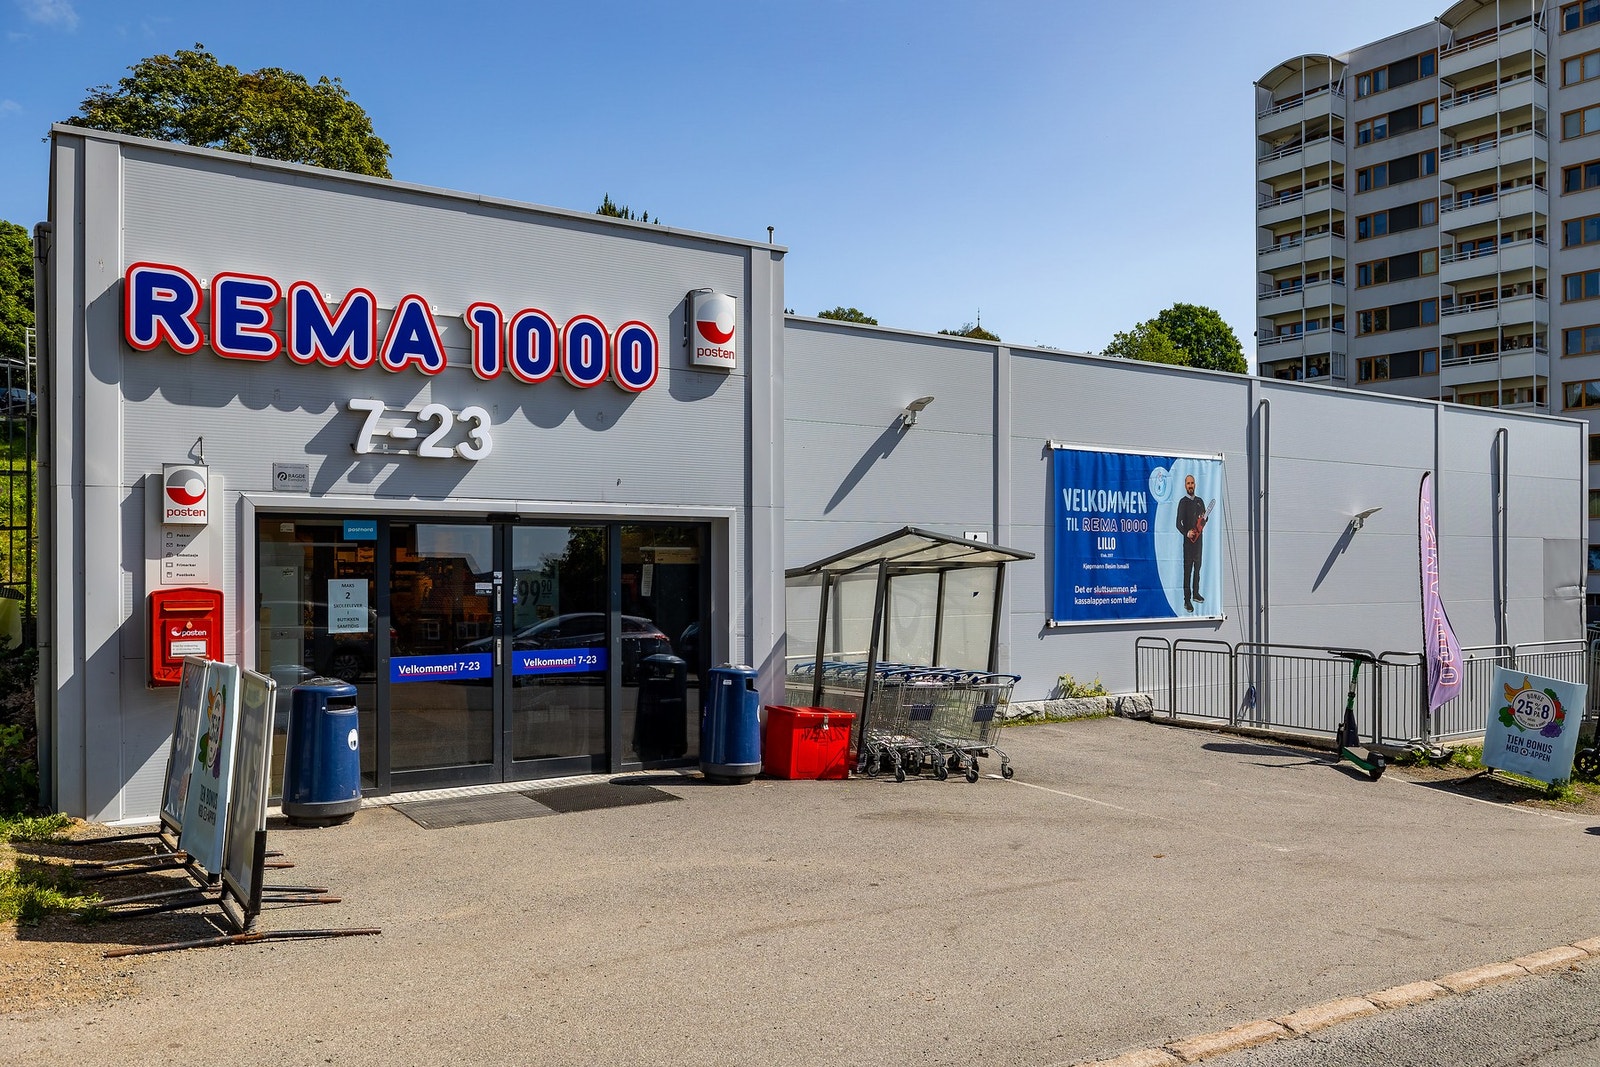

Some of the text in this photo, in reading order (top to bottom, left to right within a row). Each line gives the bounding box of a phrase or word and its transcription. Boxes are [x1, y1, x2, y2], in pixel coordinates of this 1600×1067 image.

[124, 261, 659, 392] REMA 1000
[696, 346, 735, 360] posten
[348, 398, 493, 461] 7-23
[1062, 488, 1147, 513] VELKOMMEN
[166, 507, 206, 518] posten
[1066, 517, 1148, 533] TIL REMA 1000
[1097, 536, 1116, 550] LILLO
[345, 592, 351, 600] 2
[1074, 585, 1086, 594] Det
[1093, 585, 1130, 594] sluttsummen
[1129, 584, 1138, 594] på
[1074, 597, 1110, 605] kassalappen
[181, 629, 207, 638] posten
[398, 661, 480, 676] Velkommen! 7-23
[523, 655, 597, 668] Velkommen! 7-23
[1526, 693, 1544, 702] BONUS
[1516, 699, 1534, 715] 25
[1541, 705, 1550, 719] 8
[1506, 744, 1519, 753] MED
[1507, 734, 1553, 753] TJEN BONUS
